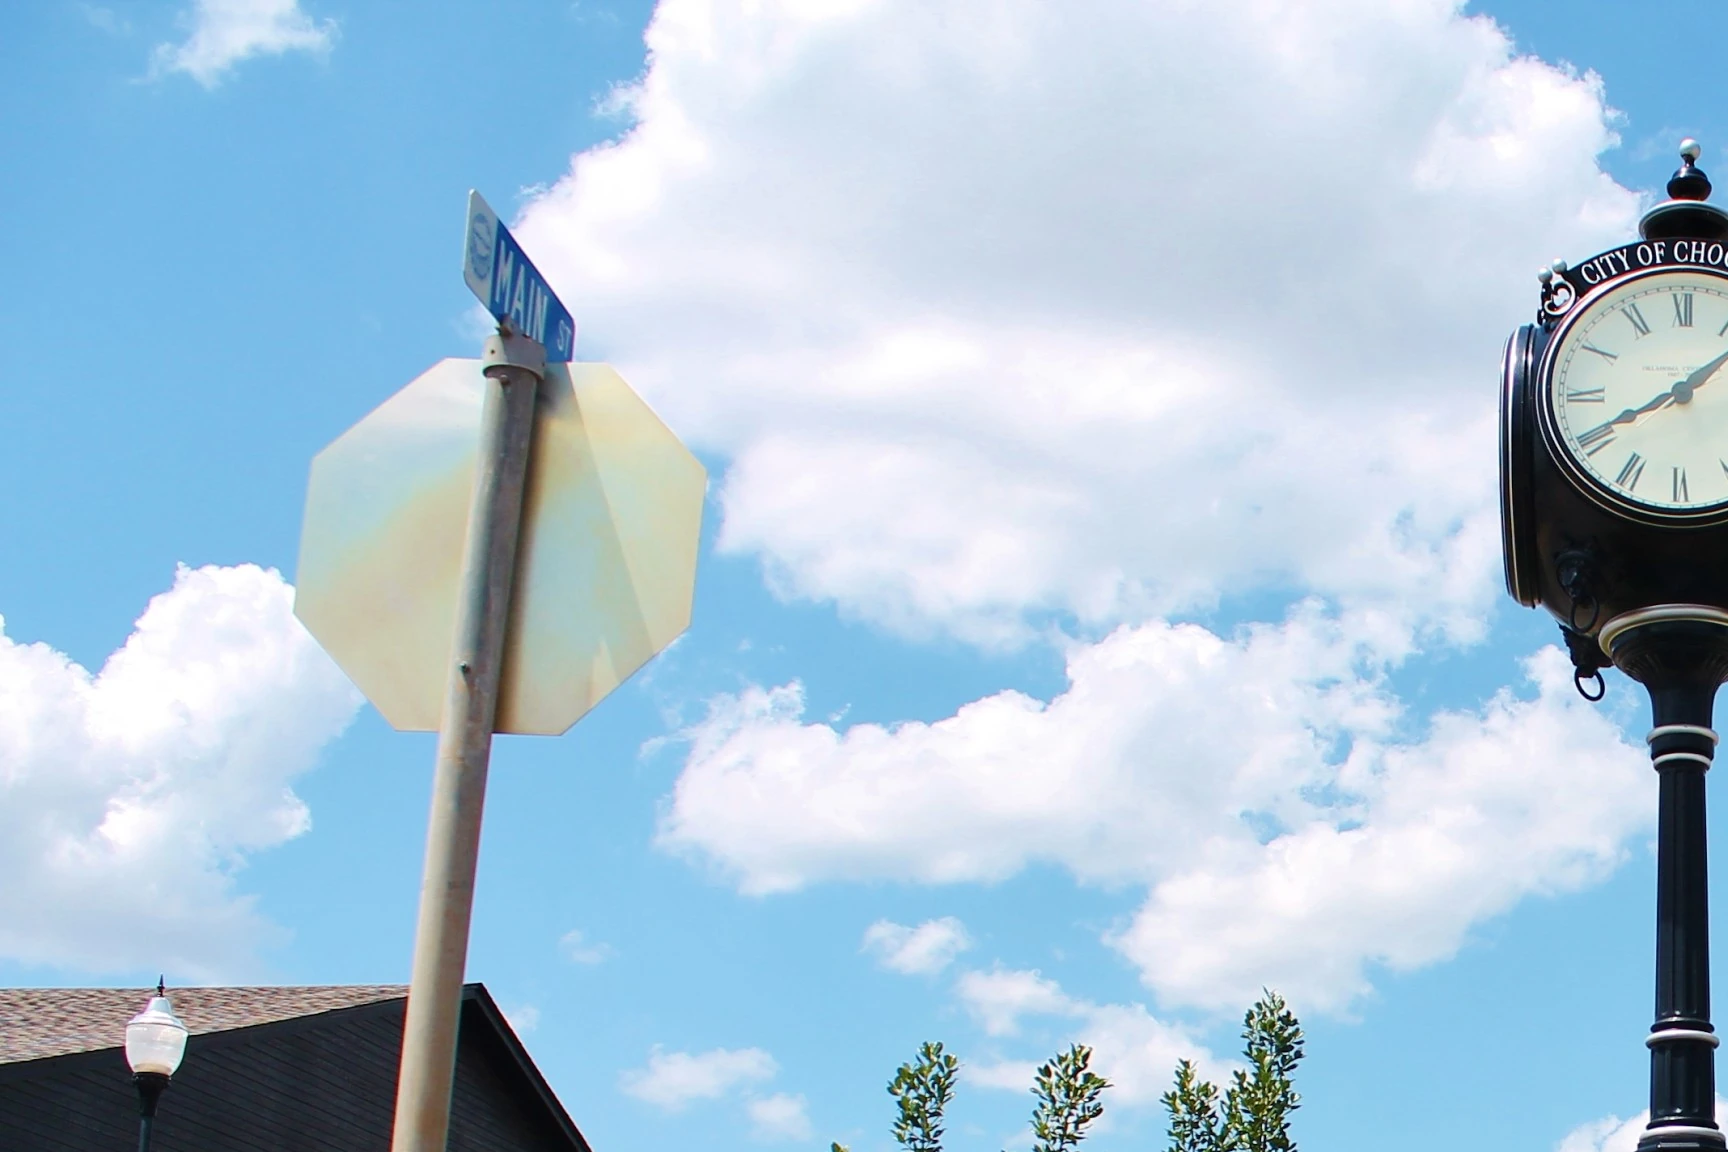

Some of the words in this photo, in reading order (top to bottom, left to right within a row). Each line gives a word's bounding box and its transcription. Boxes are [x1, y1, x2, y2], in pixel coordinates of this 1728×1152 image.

[1581, 248, 1628, 284] CITY
[1637, 241, 1666, 266] OF
[495, 239, 548, 344] MAIN
[557, 319, 572, 358] ST
[1672, 293, 1694, 328] XII
[1620, 303, 1652, 340] XI
[1566, 386, 1605, 404] IX
[1614, 451, 1648, 492] VII
[1672, 467, 1689, 502] VI
